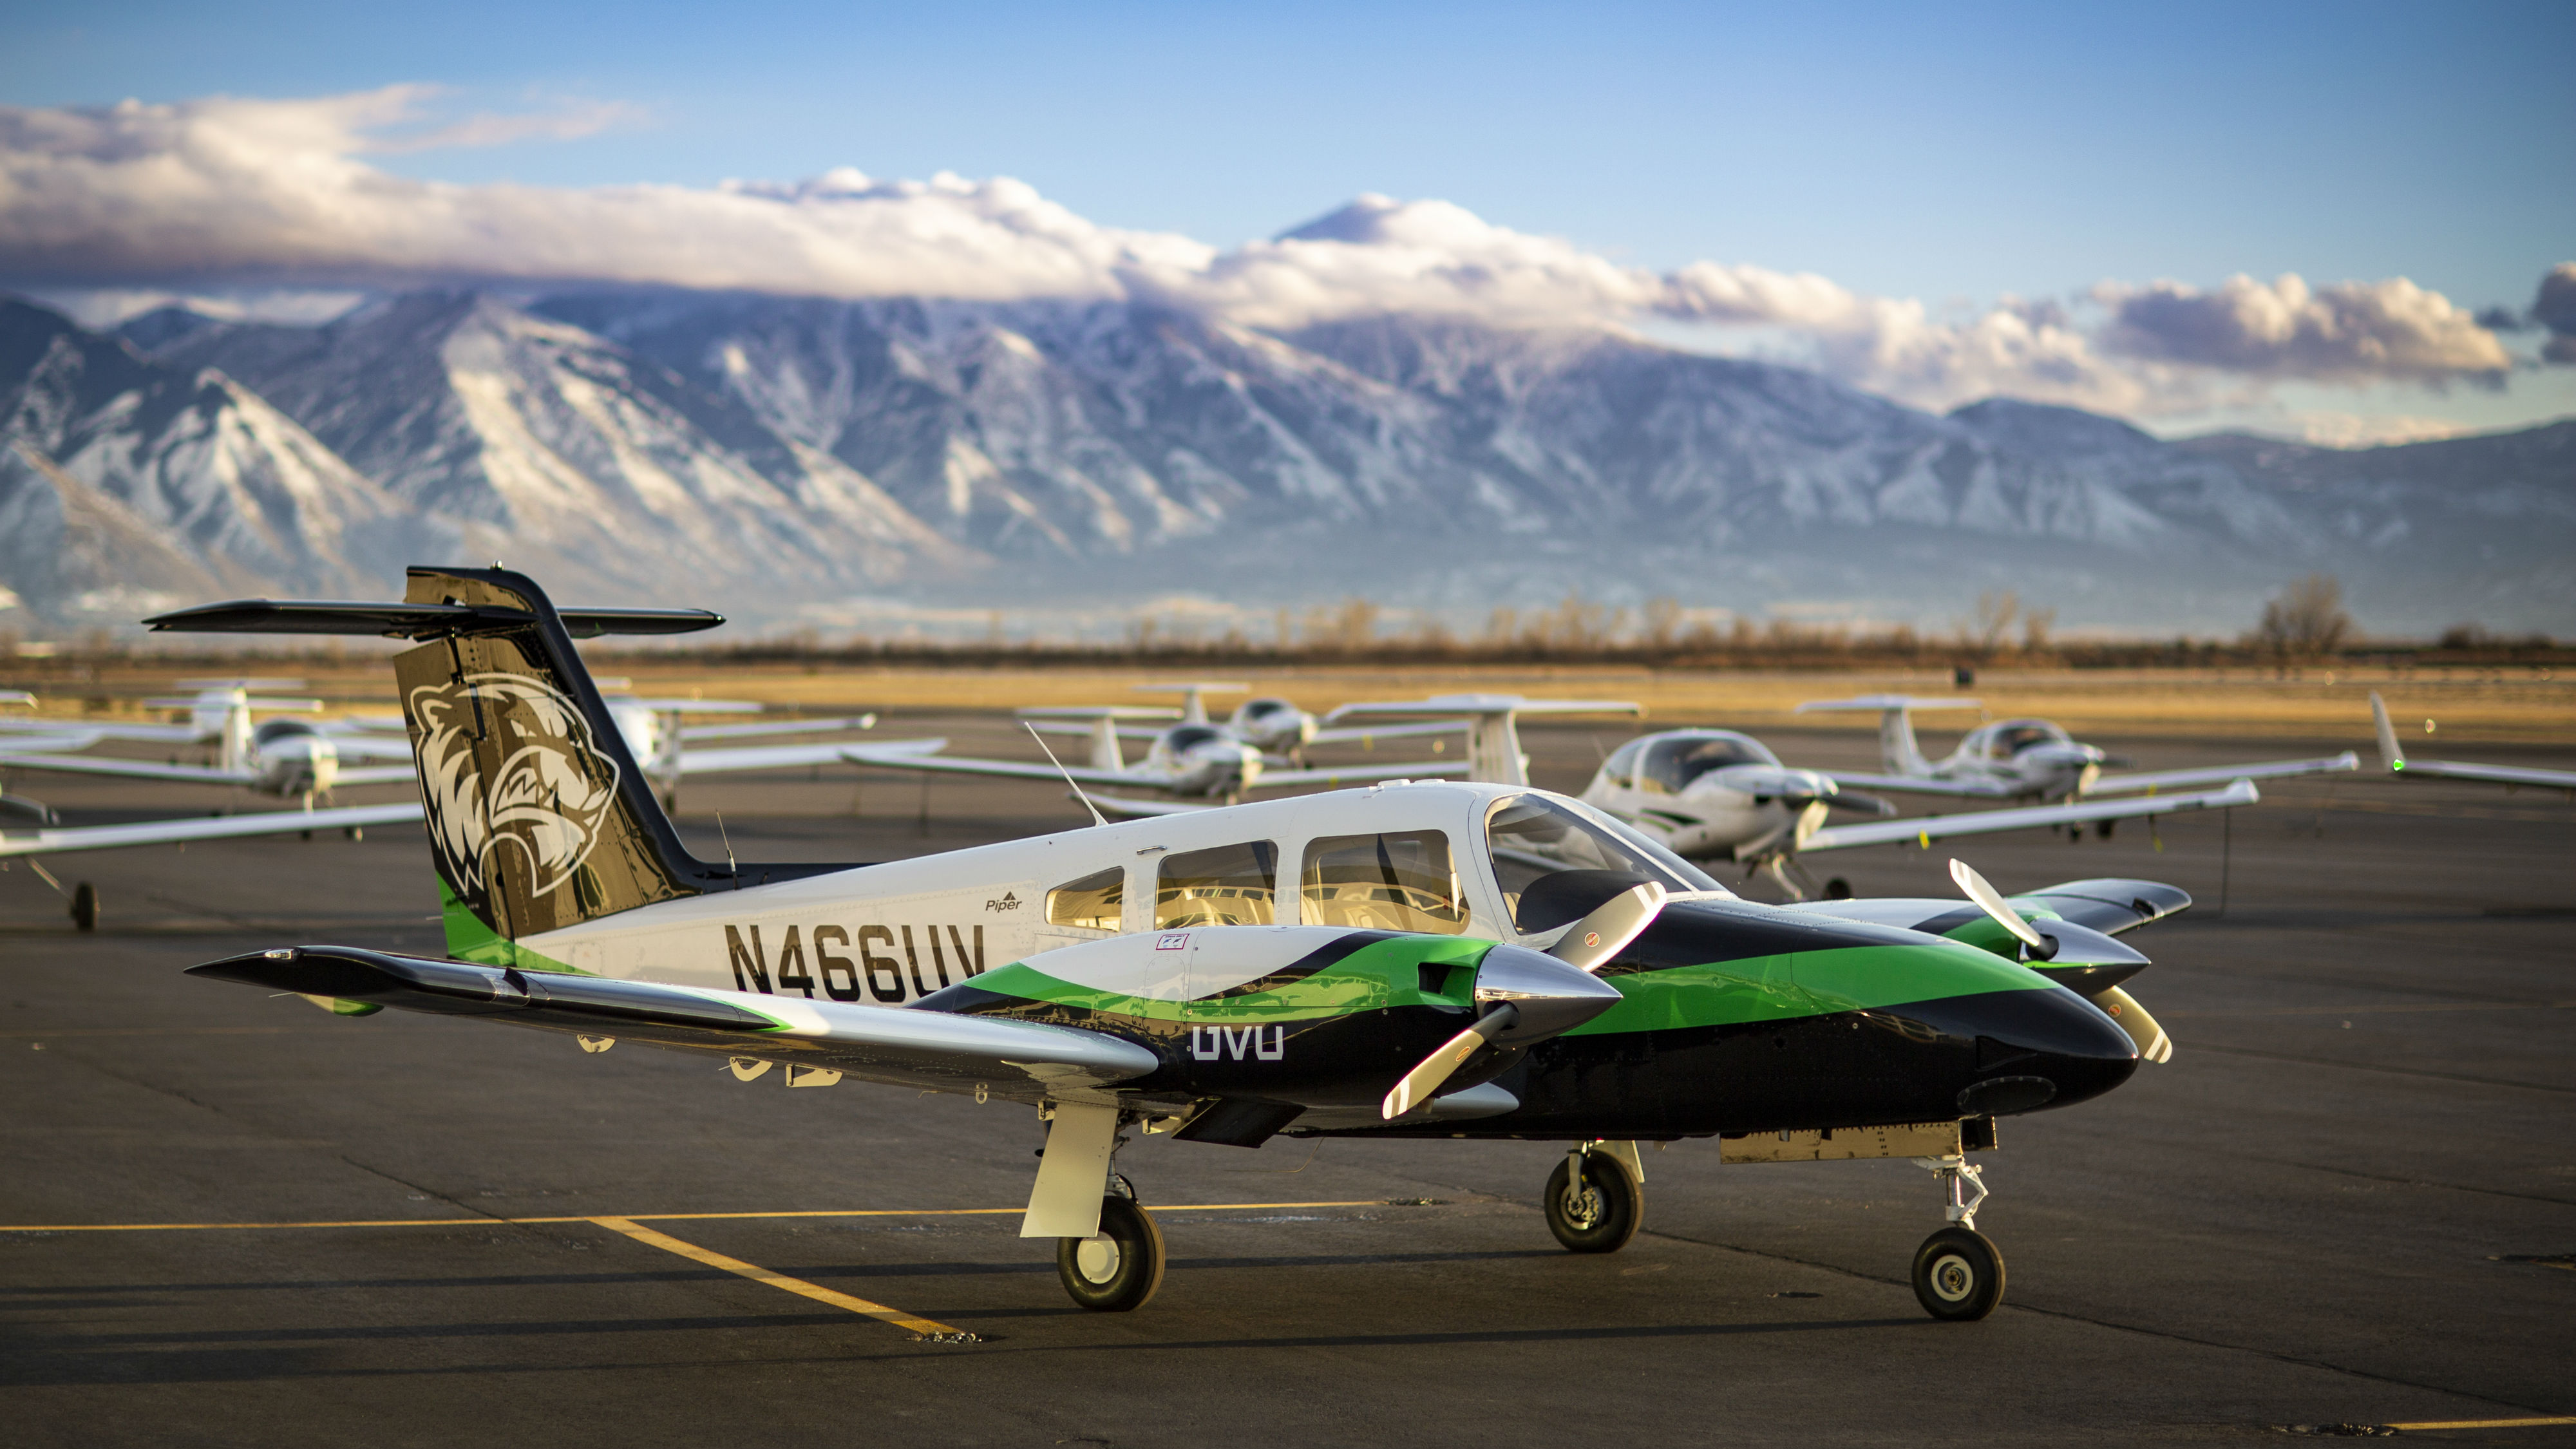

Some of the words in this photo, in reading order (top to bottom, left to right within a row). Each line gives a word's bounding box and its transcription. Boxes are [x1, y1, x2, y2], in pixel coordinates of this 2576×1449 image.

[985, 900, 1022, 913] Piper
[724, 925, 985, 1003] N466UV
[1193, 1026, 1283, 1060] UVU
